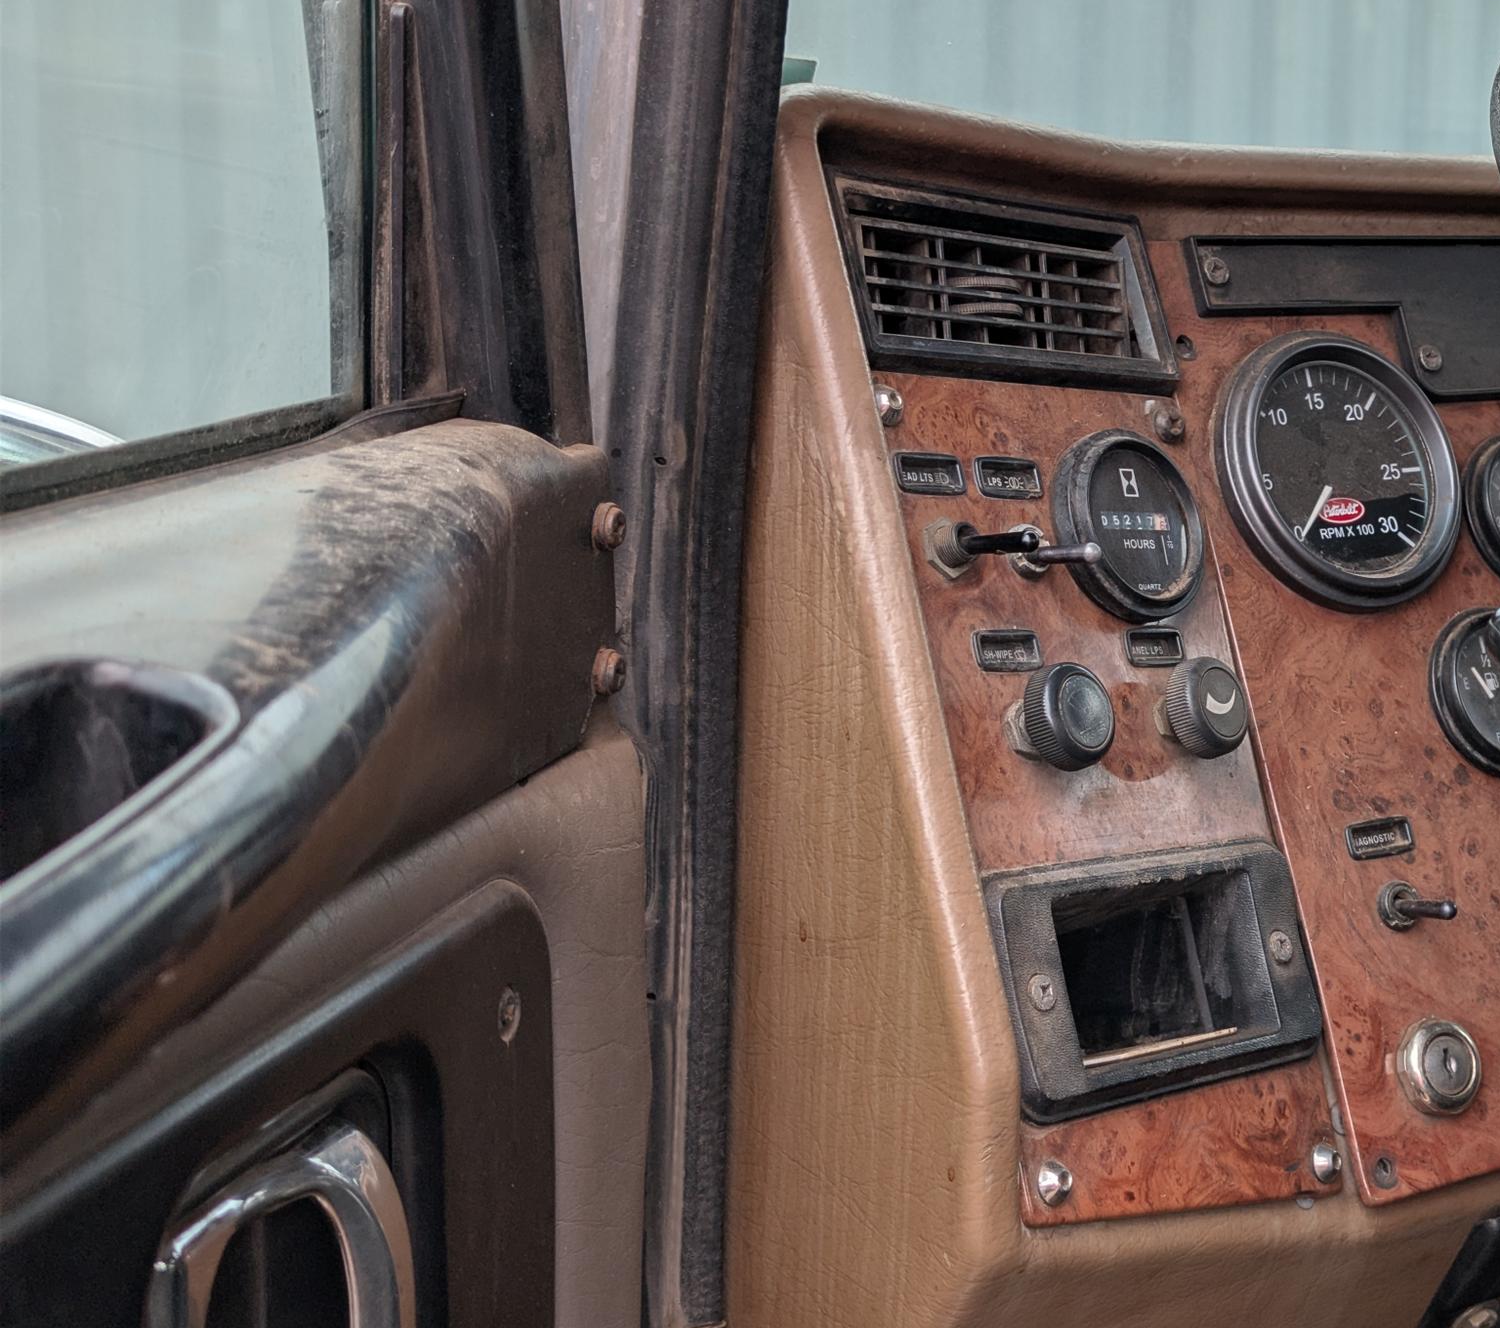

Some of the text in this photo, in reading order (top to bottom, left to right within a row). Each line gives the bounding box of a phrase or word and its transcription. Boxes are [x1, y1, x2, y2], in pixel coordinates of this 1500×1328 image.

[1304, 392, 1325, 410] 15
[1268, 408, 1288, 426] 10
[1344, 403, 1364, 421] 20
[1380, 463, 1401, 480] 25
[1262, 474, 1273, 491] 5
[1319, 523, 1375, 540] RPM X 100
[1378, 515, 1399, 534] 30
[1123, 539, 1156, 549] HOURS
